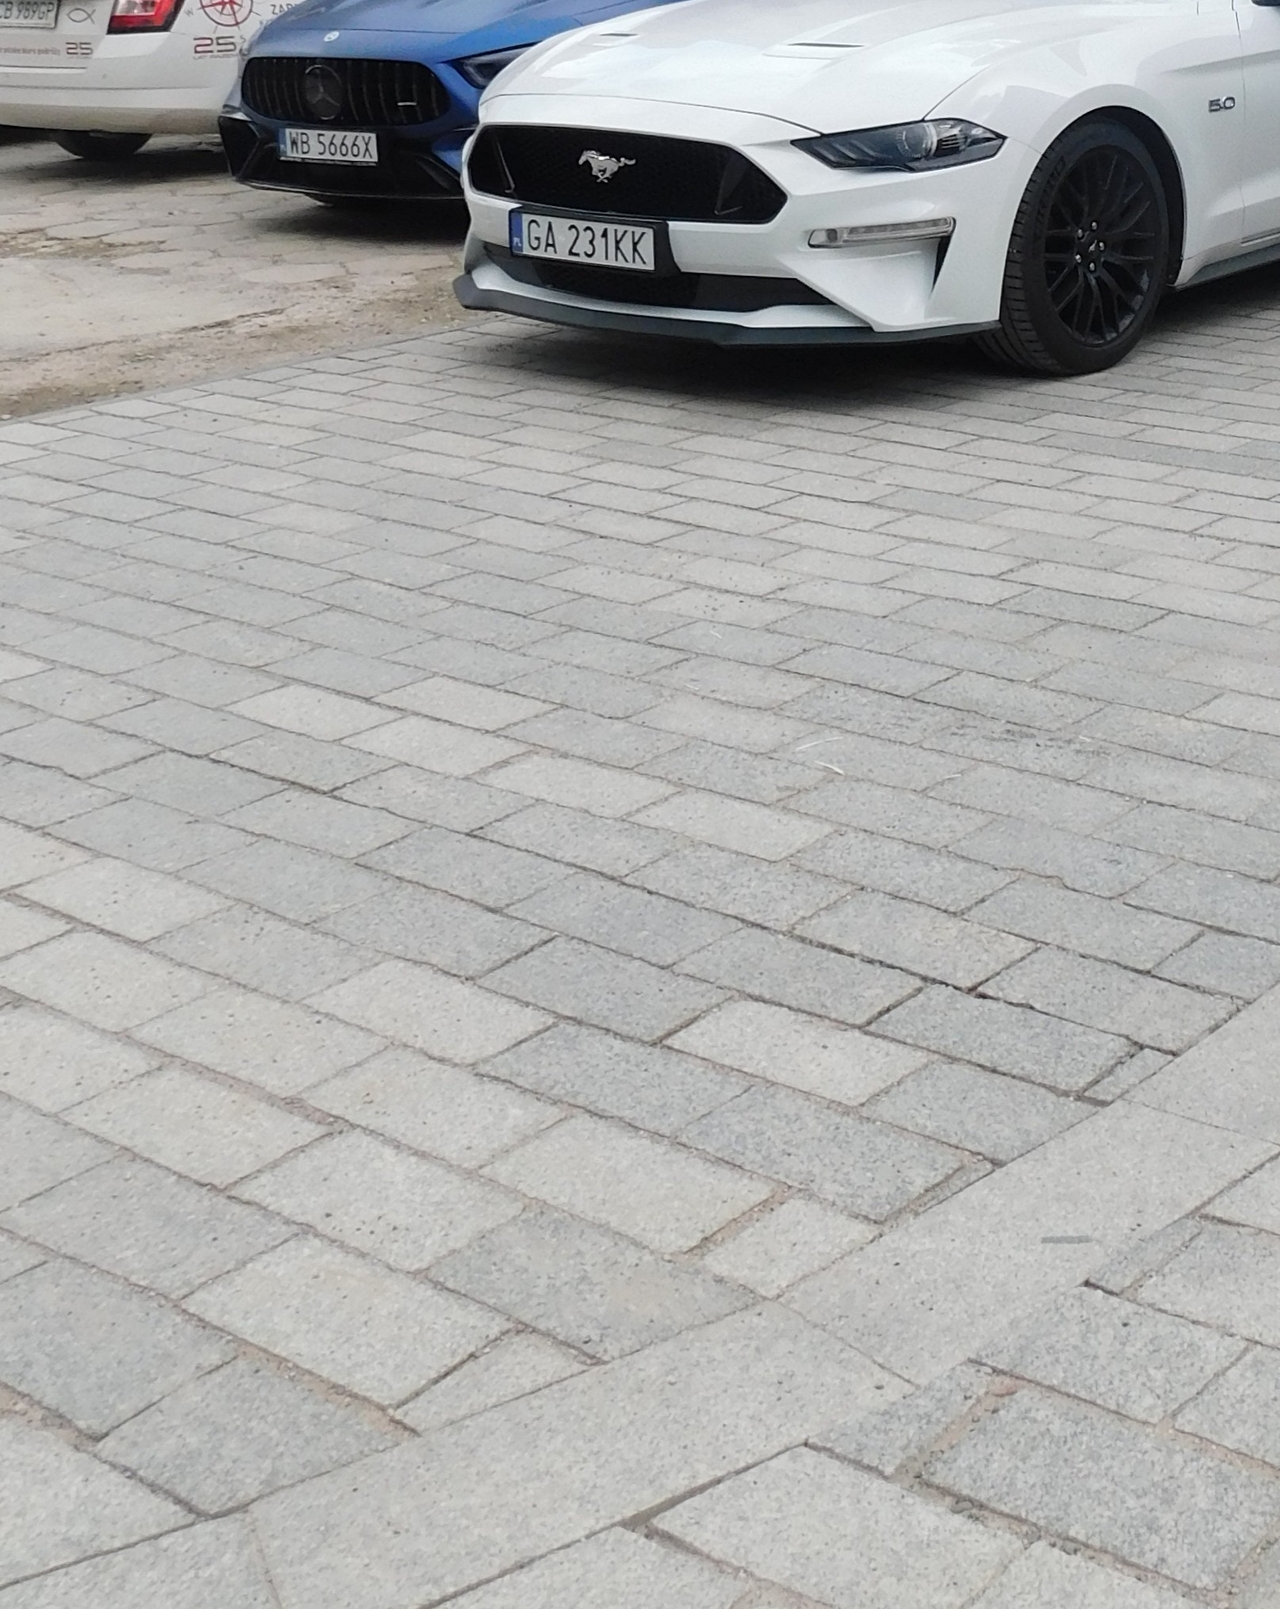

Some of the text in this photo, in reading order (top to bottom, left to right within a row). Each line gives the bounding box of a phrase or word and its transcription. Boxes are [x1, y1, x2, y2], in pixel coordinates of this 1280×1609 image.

[65, 42, 93, 55] 25
[193, 36, 237, 54] 25
[289, 131, 310, 154] WB
[317, 133, 373, 159] 5666X
[528, 219, 647, 265] GA 231KK
